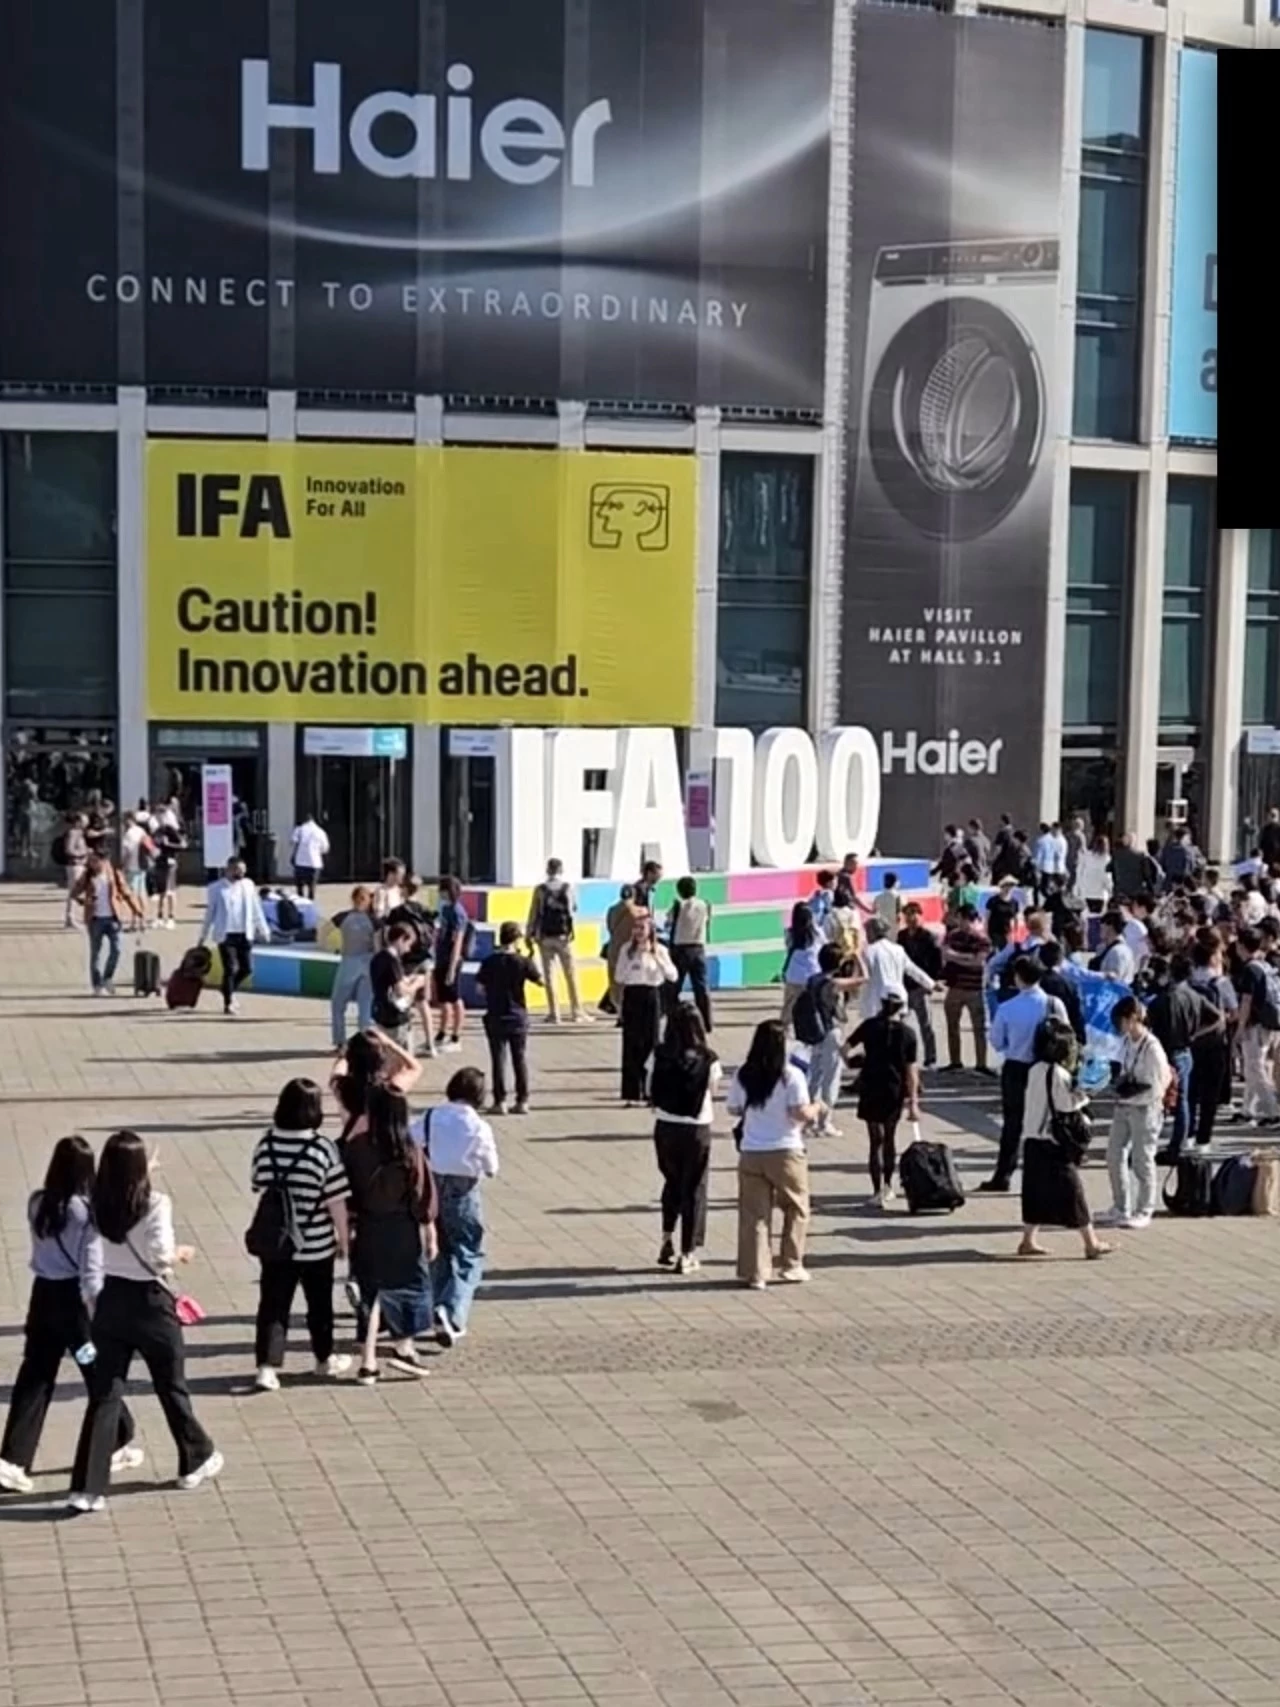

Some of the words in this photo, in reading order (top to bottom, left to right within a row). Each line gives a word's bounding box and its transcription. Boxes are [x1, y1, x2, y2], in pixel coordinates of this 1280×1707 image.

[240, 59, 613, 187] Haier
[86, 273, 296, 308] CONNECT
[322, 281, 375, 312] TO
[402, 284, 751, 329] EXTRAORDINARY
[176, 472, 291, 538] IFA
[305, 475, 406, 497] Innovation
[305, 498, 336, 517] For
[339, 499, 366, 518] All
[177, 586, 377, 636] Caution!
[923, 608, 973, 622] VISIT
[868, 628, 925, 642] HAIER
[935, 629, 1022, 644] PAVILLON
[888, 649, 910, 662] AT
[920, 649, 964, 663] HALL
[973, 651, 1001, 664] 3.1
[177, 648, 427, 696] Innovation
[438, 653, 590, 698] ahead.
[881, 729, 1003, 776] Haier
[513, 727, 692, 886] IFA
[712, 726, 882, 873] 100
